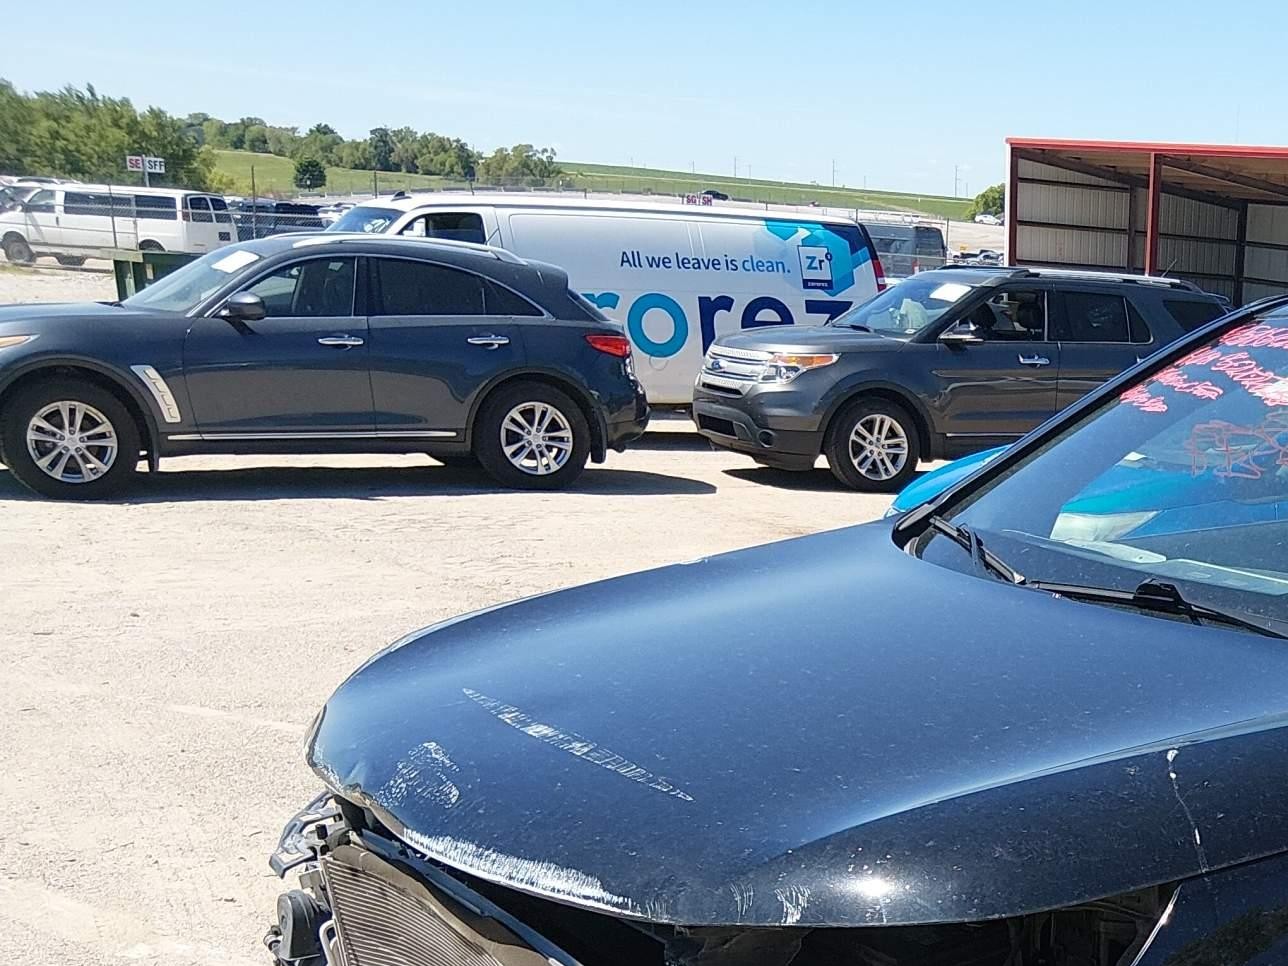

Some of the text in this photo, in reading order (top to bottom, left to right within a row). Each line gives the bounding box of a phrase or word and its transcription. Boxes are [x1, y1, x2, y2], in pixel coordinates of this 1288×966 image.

[147, 159, 165, 171] SFF
[620, 250, 791, 274] All we leave is clean.
